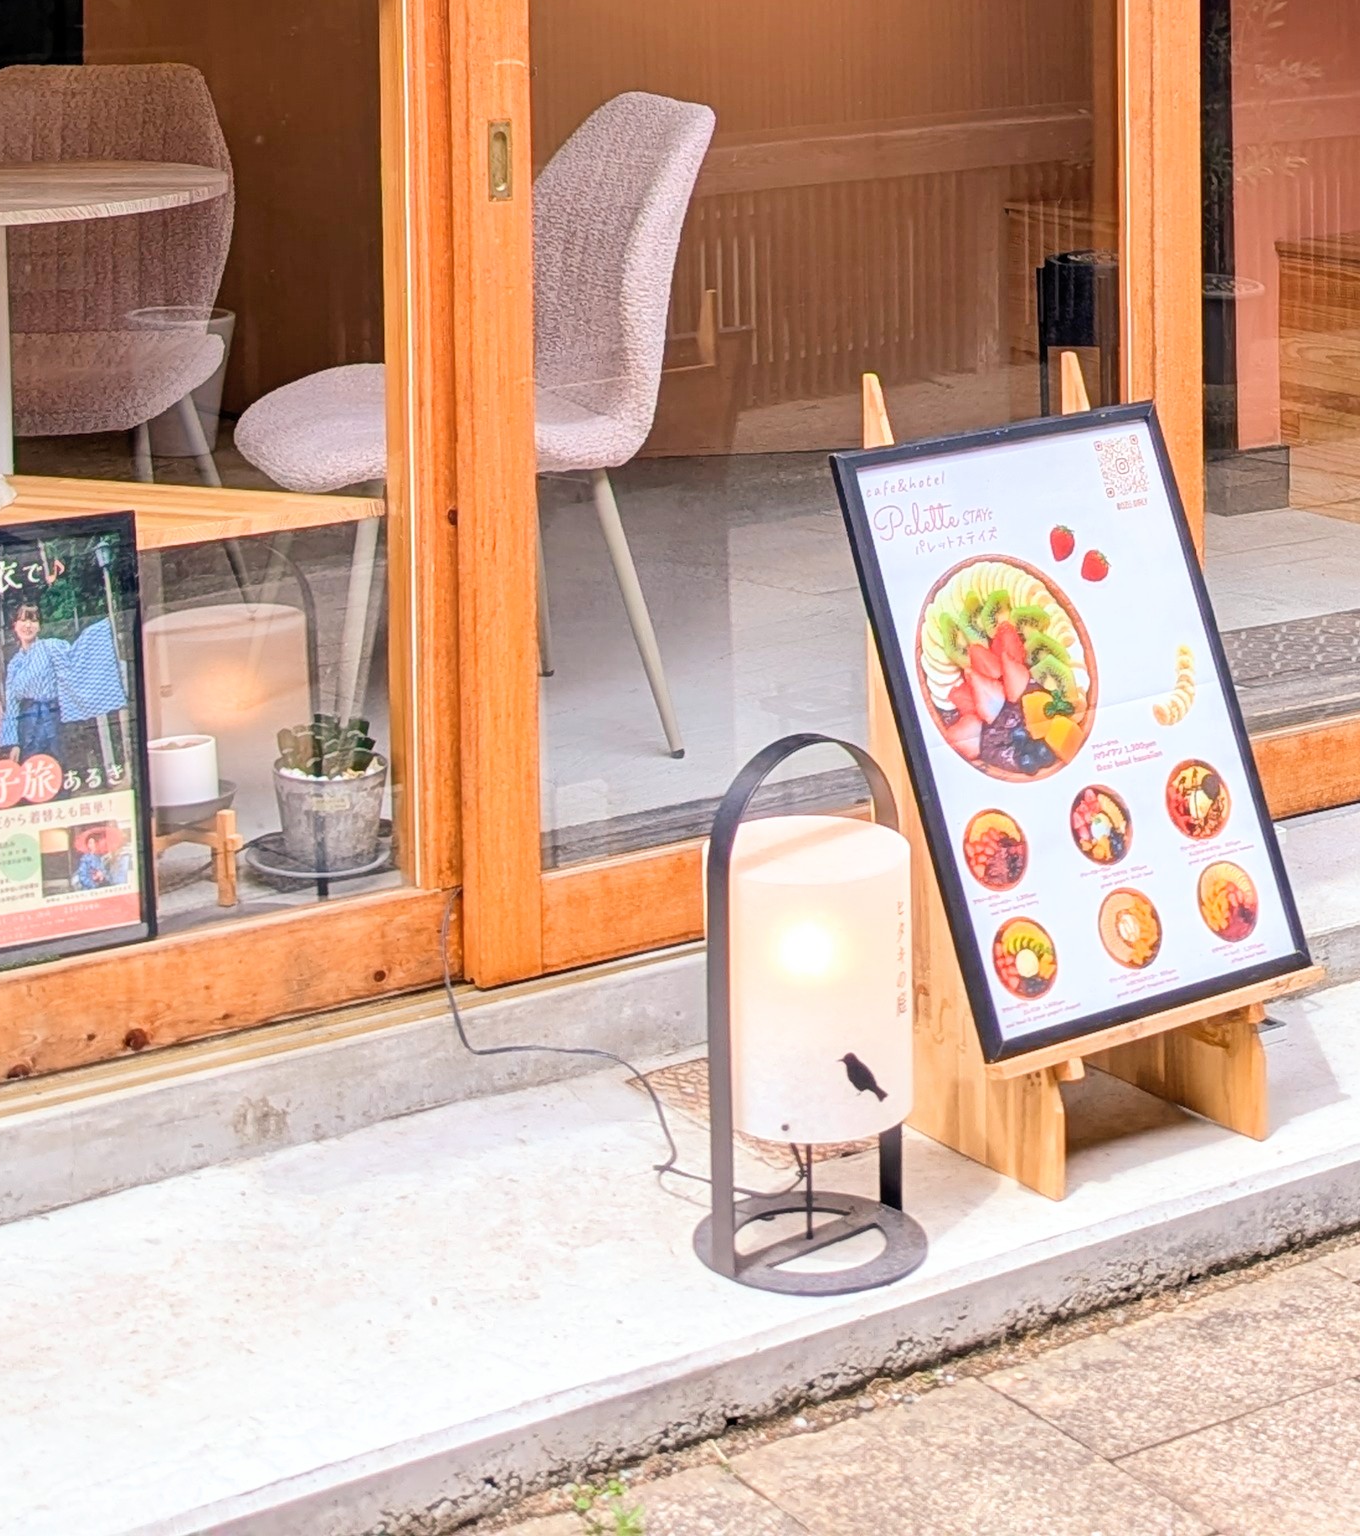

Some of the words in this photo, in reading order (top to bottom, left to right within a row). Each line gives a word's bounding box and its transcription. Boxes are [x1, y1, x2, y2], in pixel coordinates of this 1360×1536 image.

[866, 471, 946, 498] cafe&hotel
[873, 502, 960, 542] Palette
[915, 527, 998, 556] パレットステイズ
